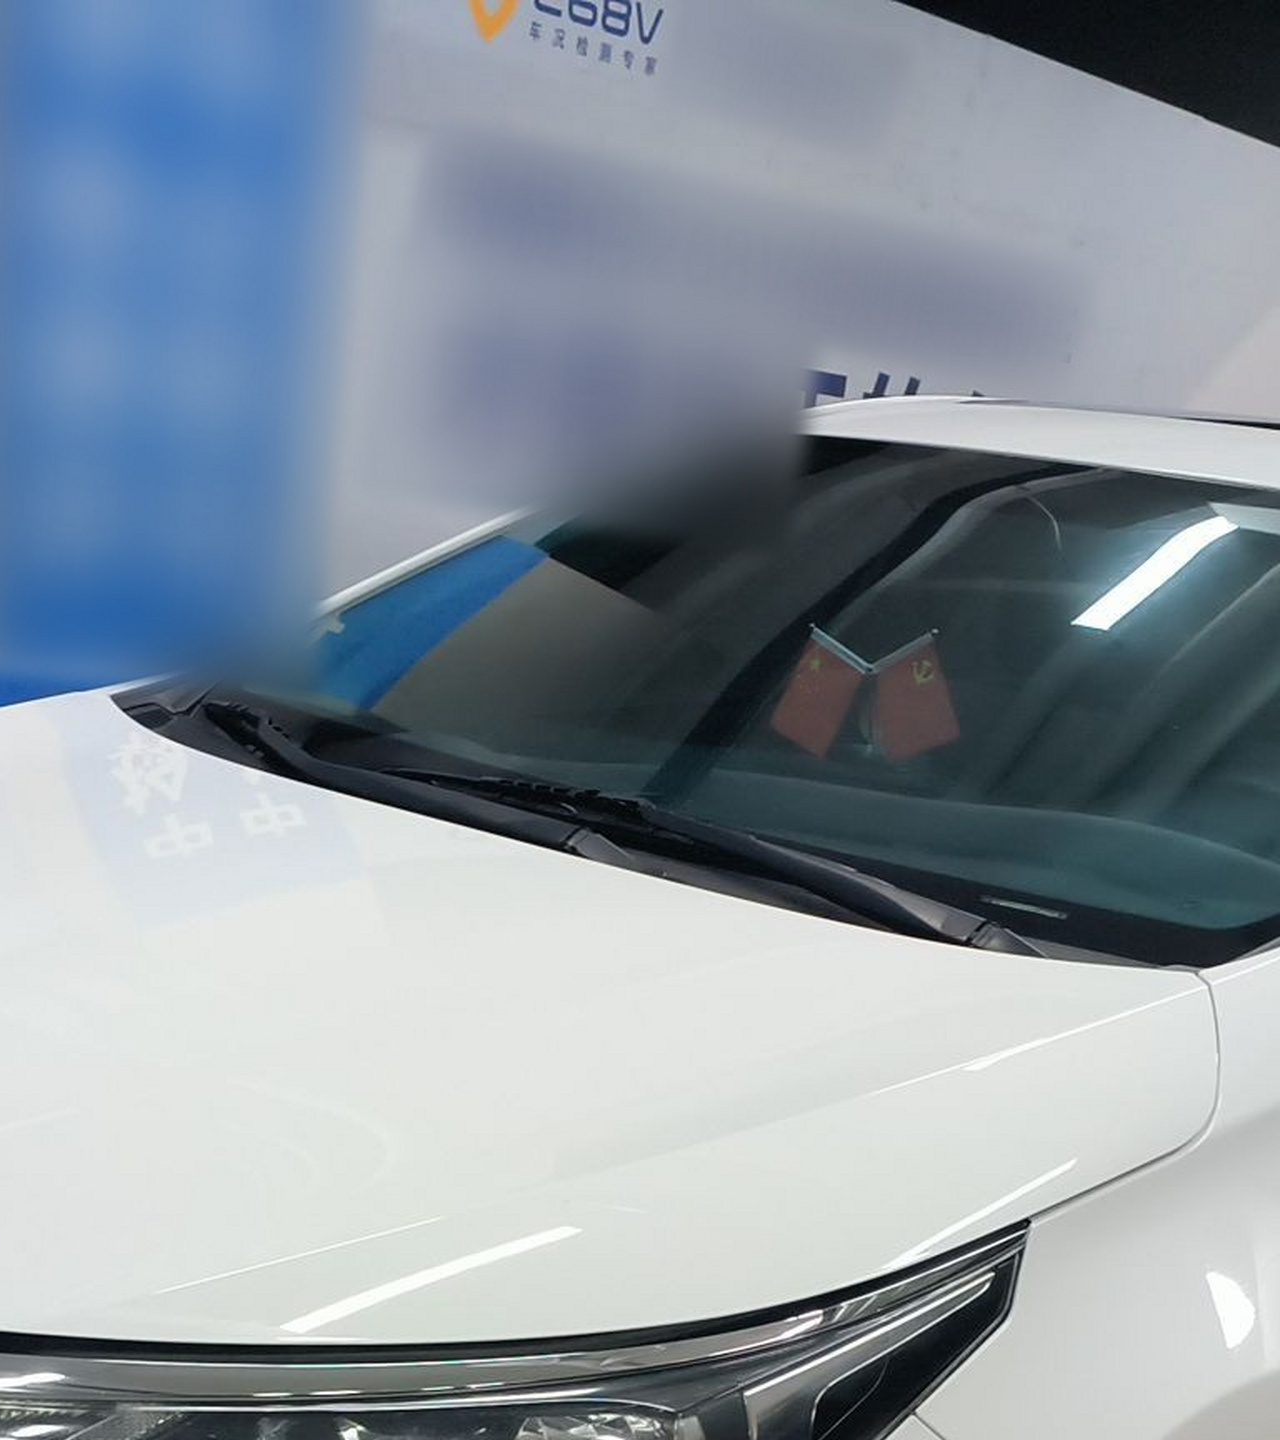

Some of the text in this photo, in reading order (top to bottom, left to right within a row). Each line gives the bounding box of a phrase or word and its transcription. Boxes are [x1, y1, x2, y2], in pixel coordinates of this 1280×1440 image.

[529, 21, 658, 76] 车况检测专家
